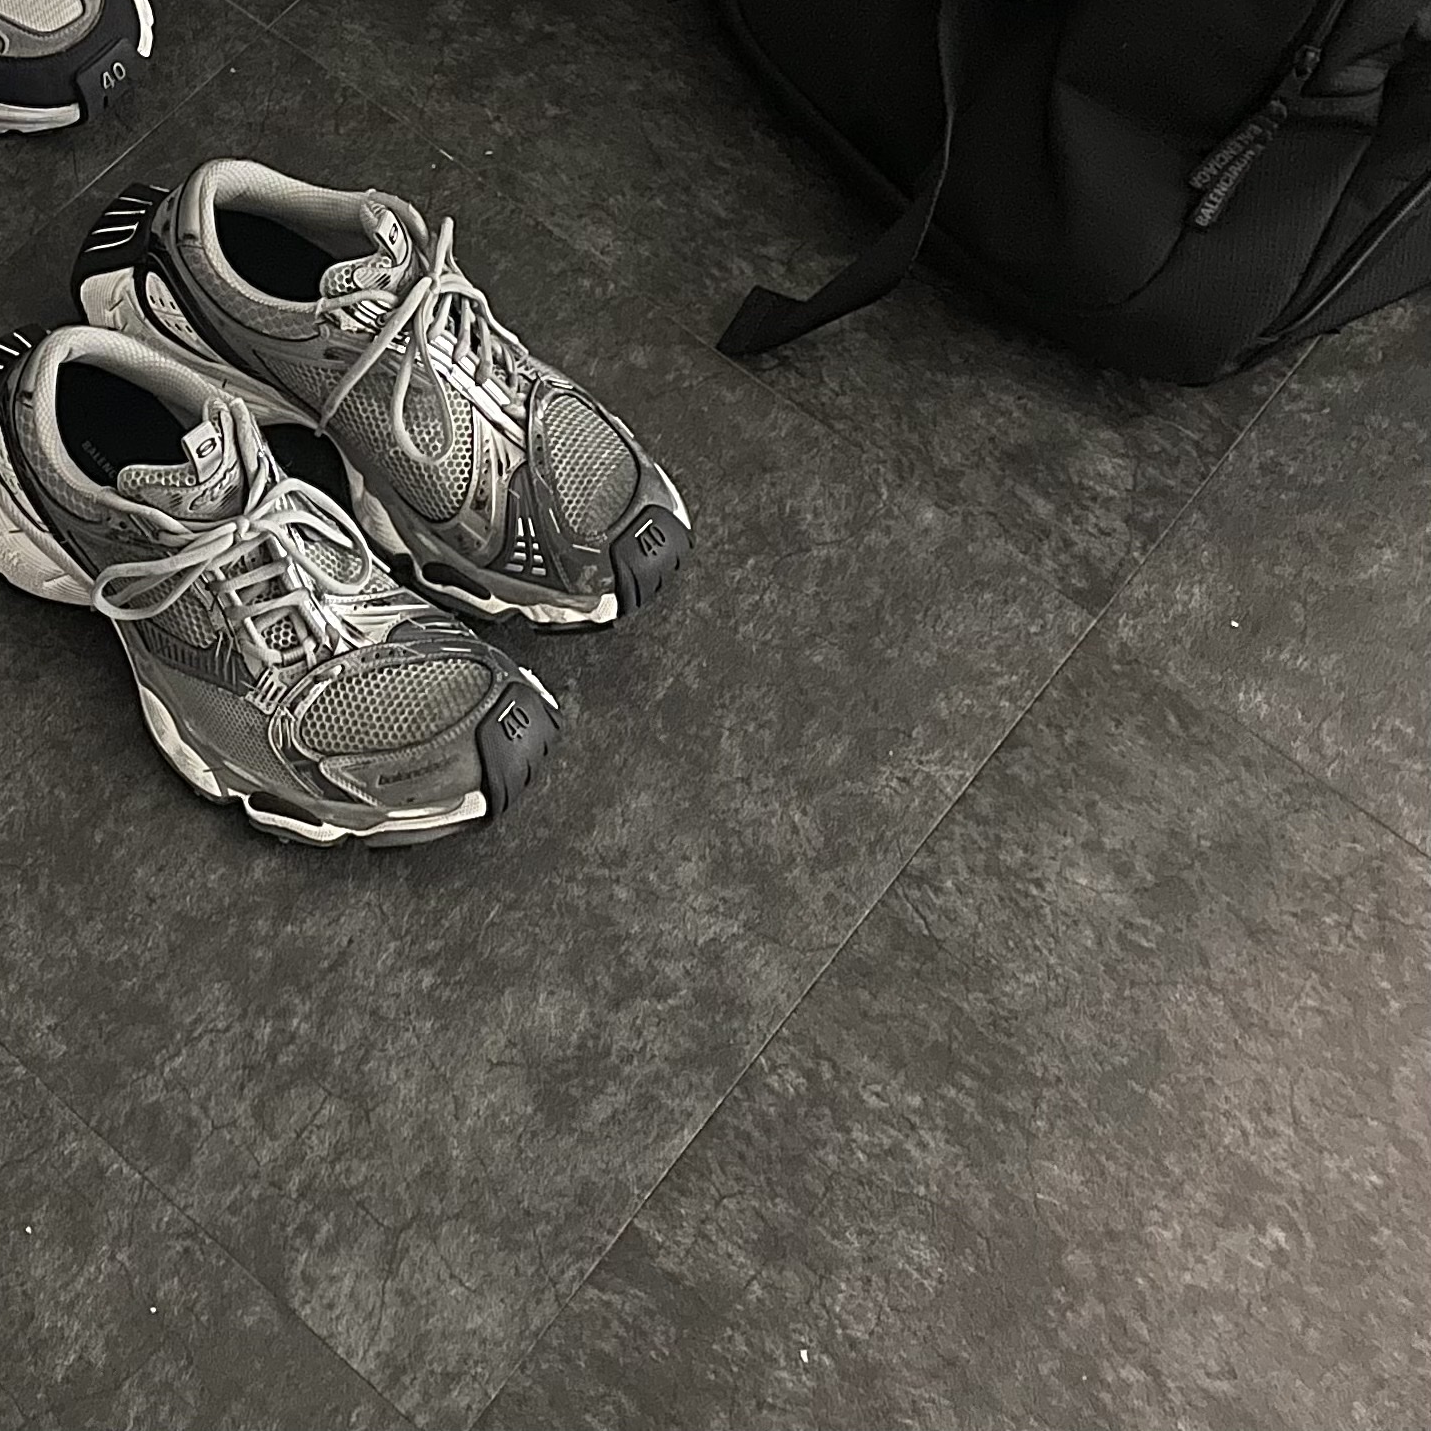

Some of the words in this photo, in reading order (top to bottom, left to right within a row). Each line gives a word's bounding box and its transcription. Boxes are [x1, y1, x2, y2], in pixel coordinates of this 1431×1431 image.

[102, 62, 127, 90] 40
[637, 524, 666, 558] 40
[500, 707, 530, 742] 40
